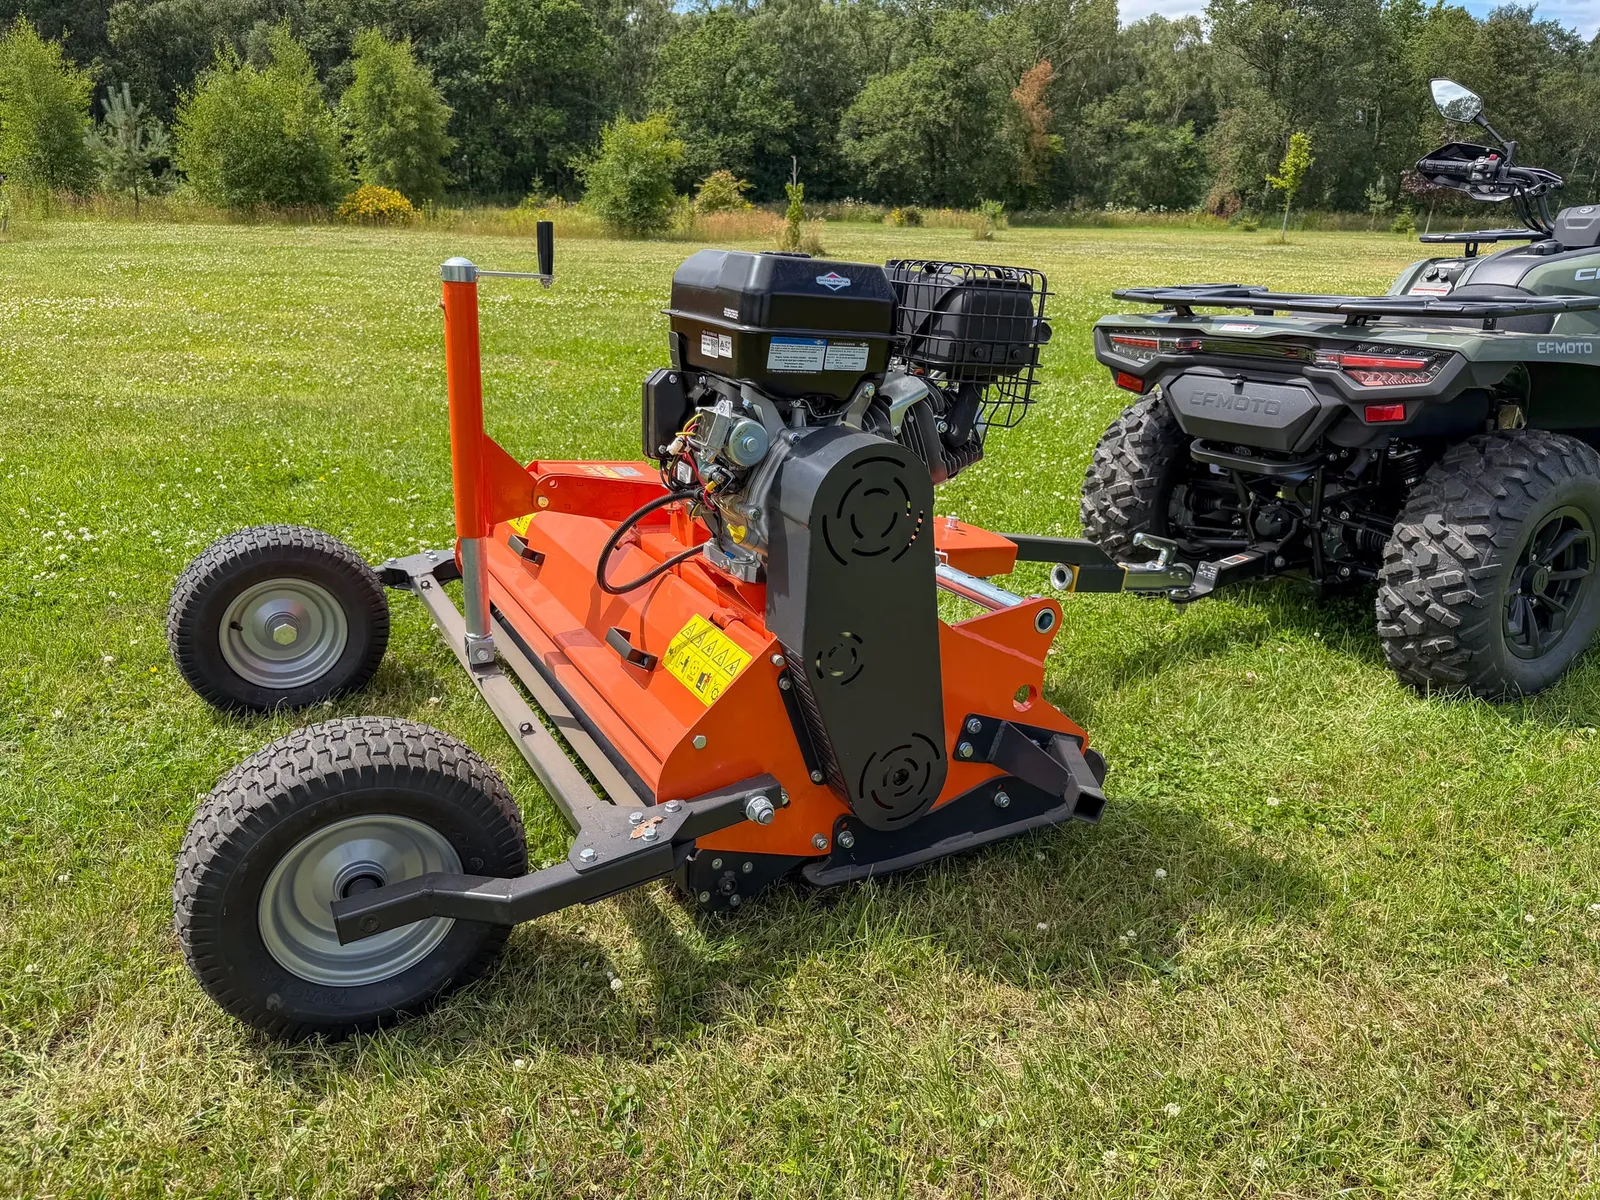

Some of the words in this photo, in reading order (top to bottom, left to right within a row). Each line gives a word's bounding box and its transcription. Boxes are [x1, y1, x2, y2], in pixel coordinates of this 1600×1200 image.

[1575, 268, 1600, 281] C
[1537, 342, 1592, 354] CFMOTO
[1189, 390, 1281, 415] CFMOTO
